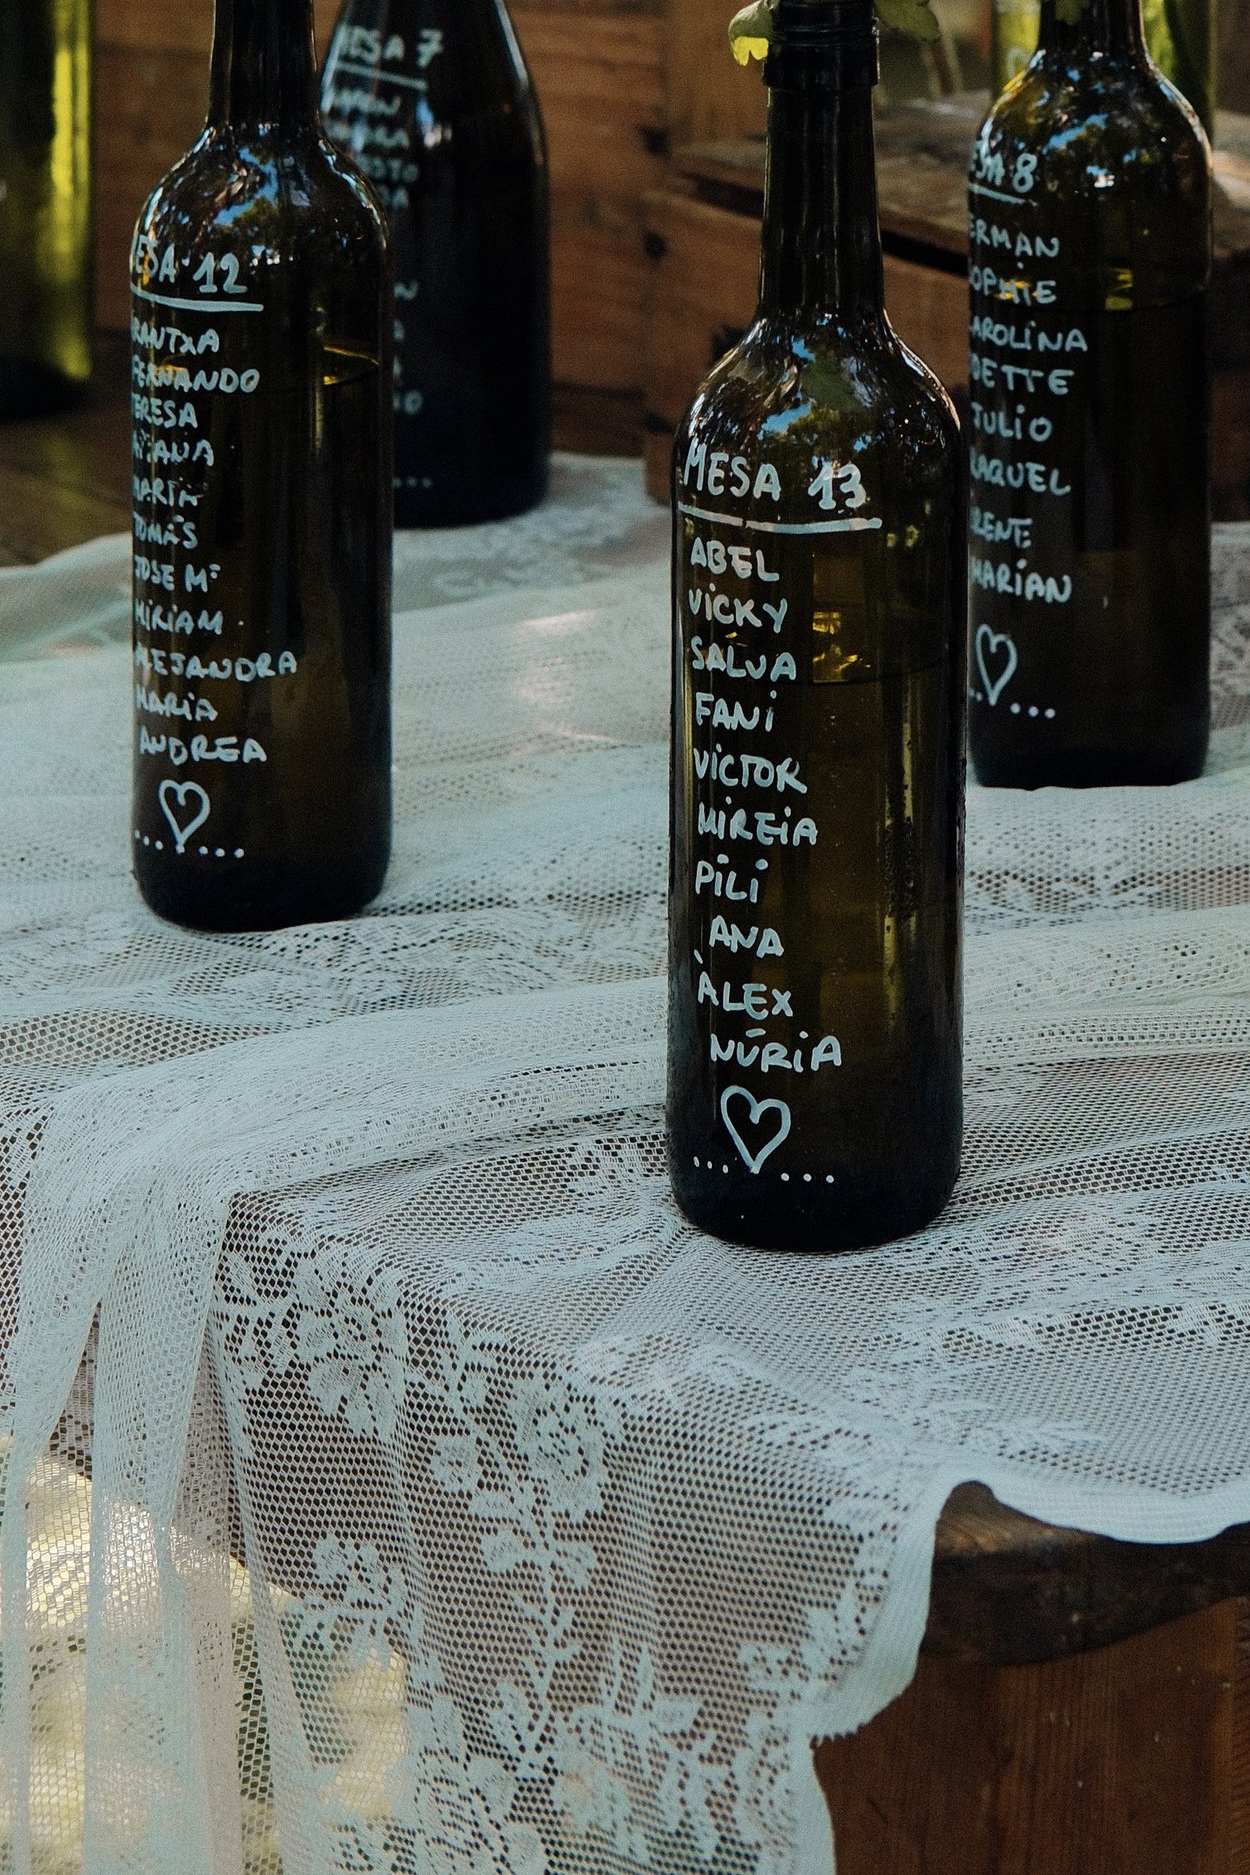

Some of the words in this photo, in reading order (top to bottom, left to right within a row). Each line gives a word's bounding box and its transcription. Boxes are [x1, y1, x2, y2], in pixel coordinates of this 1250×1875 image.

[416, 28, 444, 68] 7
[1012, 152, 1037, 193] 8
[135, 234, 176, 283] ESA
[193, 251, 248, 293] 12
[970, 262, 1056, 306] OPHiE
[131, 317, 219, 355] RANTXA
[971, 316, 1088, 352] AROLiNA
[684, 438, 781, 501] MESA
[808, 461, 866, 510] 13
[691, 537, 779, 582] ABEL
[688, 583, 787, 634] ViCKY
[691, 636, 796, 681] SALVA
[696, 690, 777, 732] FANi
[139, 725, 267, 765] ANDREA
[693, 744, 807, 794] ViCTOR
[698, 796, 818, 846] MiREiA
[695, 854, 768, 903] PiLi
[709, 915, 785, 958] ANA
